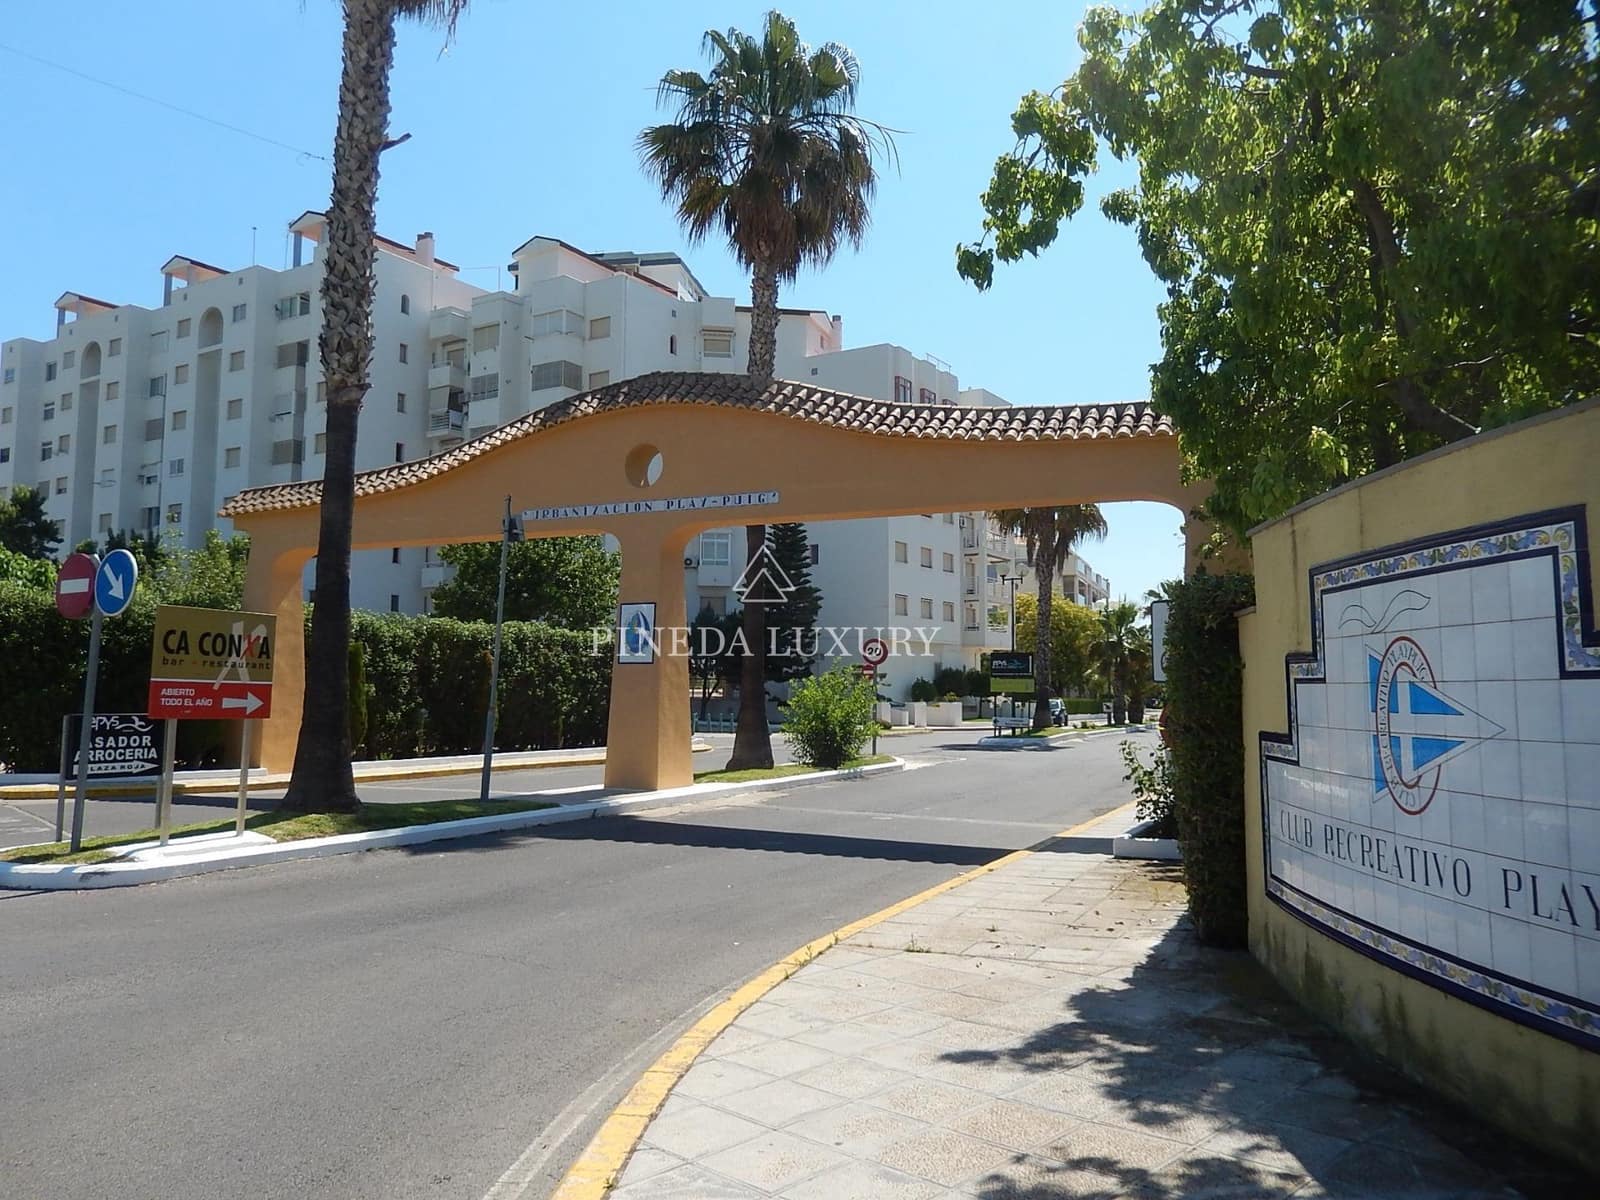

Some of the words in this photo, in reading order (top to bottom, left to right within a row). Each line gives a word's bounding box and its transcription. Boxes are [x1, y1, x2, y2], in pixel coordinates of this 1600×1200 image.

[163, 629, 190, 655] CA
[198, 632, 271, 660] CONXA
[162, 656, 185, 666] bar
[202, 659, 271, 670] restaurant
[160, 688, 196, 697] ABIERTO
[161, 698, 183, 707] TODO
[183, 698, 195, 707] EL
[195, 697, 213, 707] AÑO
[88, 735, 152, 749] SADOR
[90, 764, 117, 772] LAZA
[1280, 809, 1313, 848] CLUB
[1324, 823, 1471, 898] RECREATIVO
